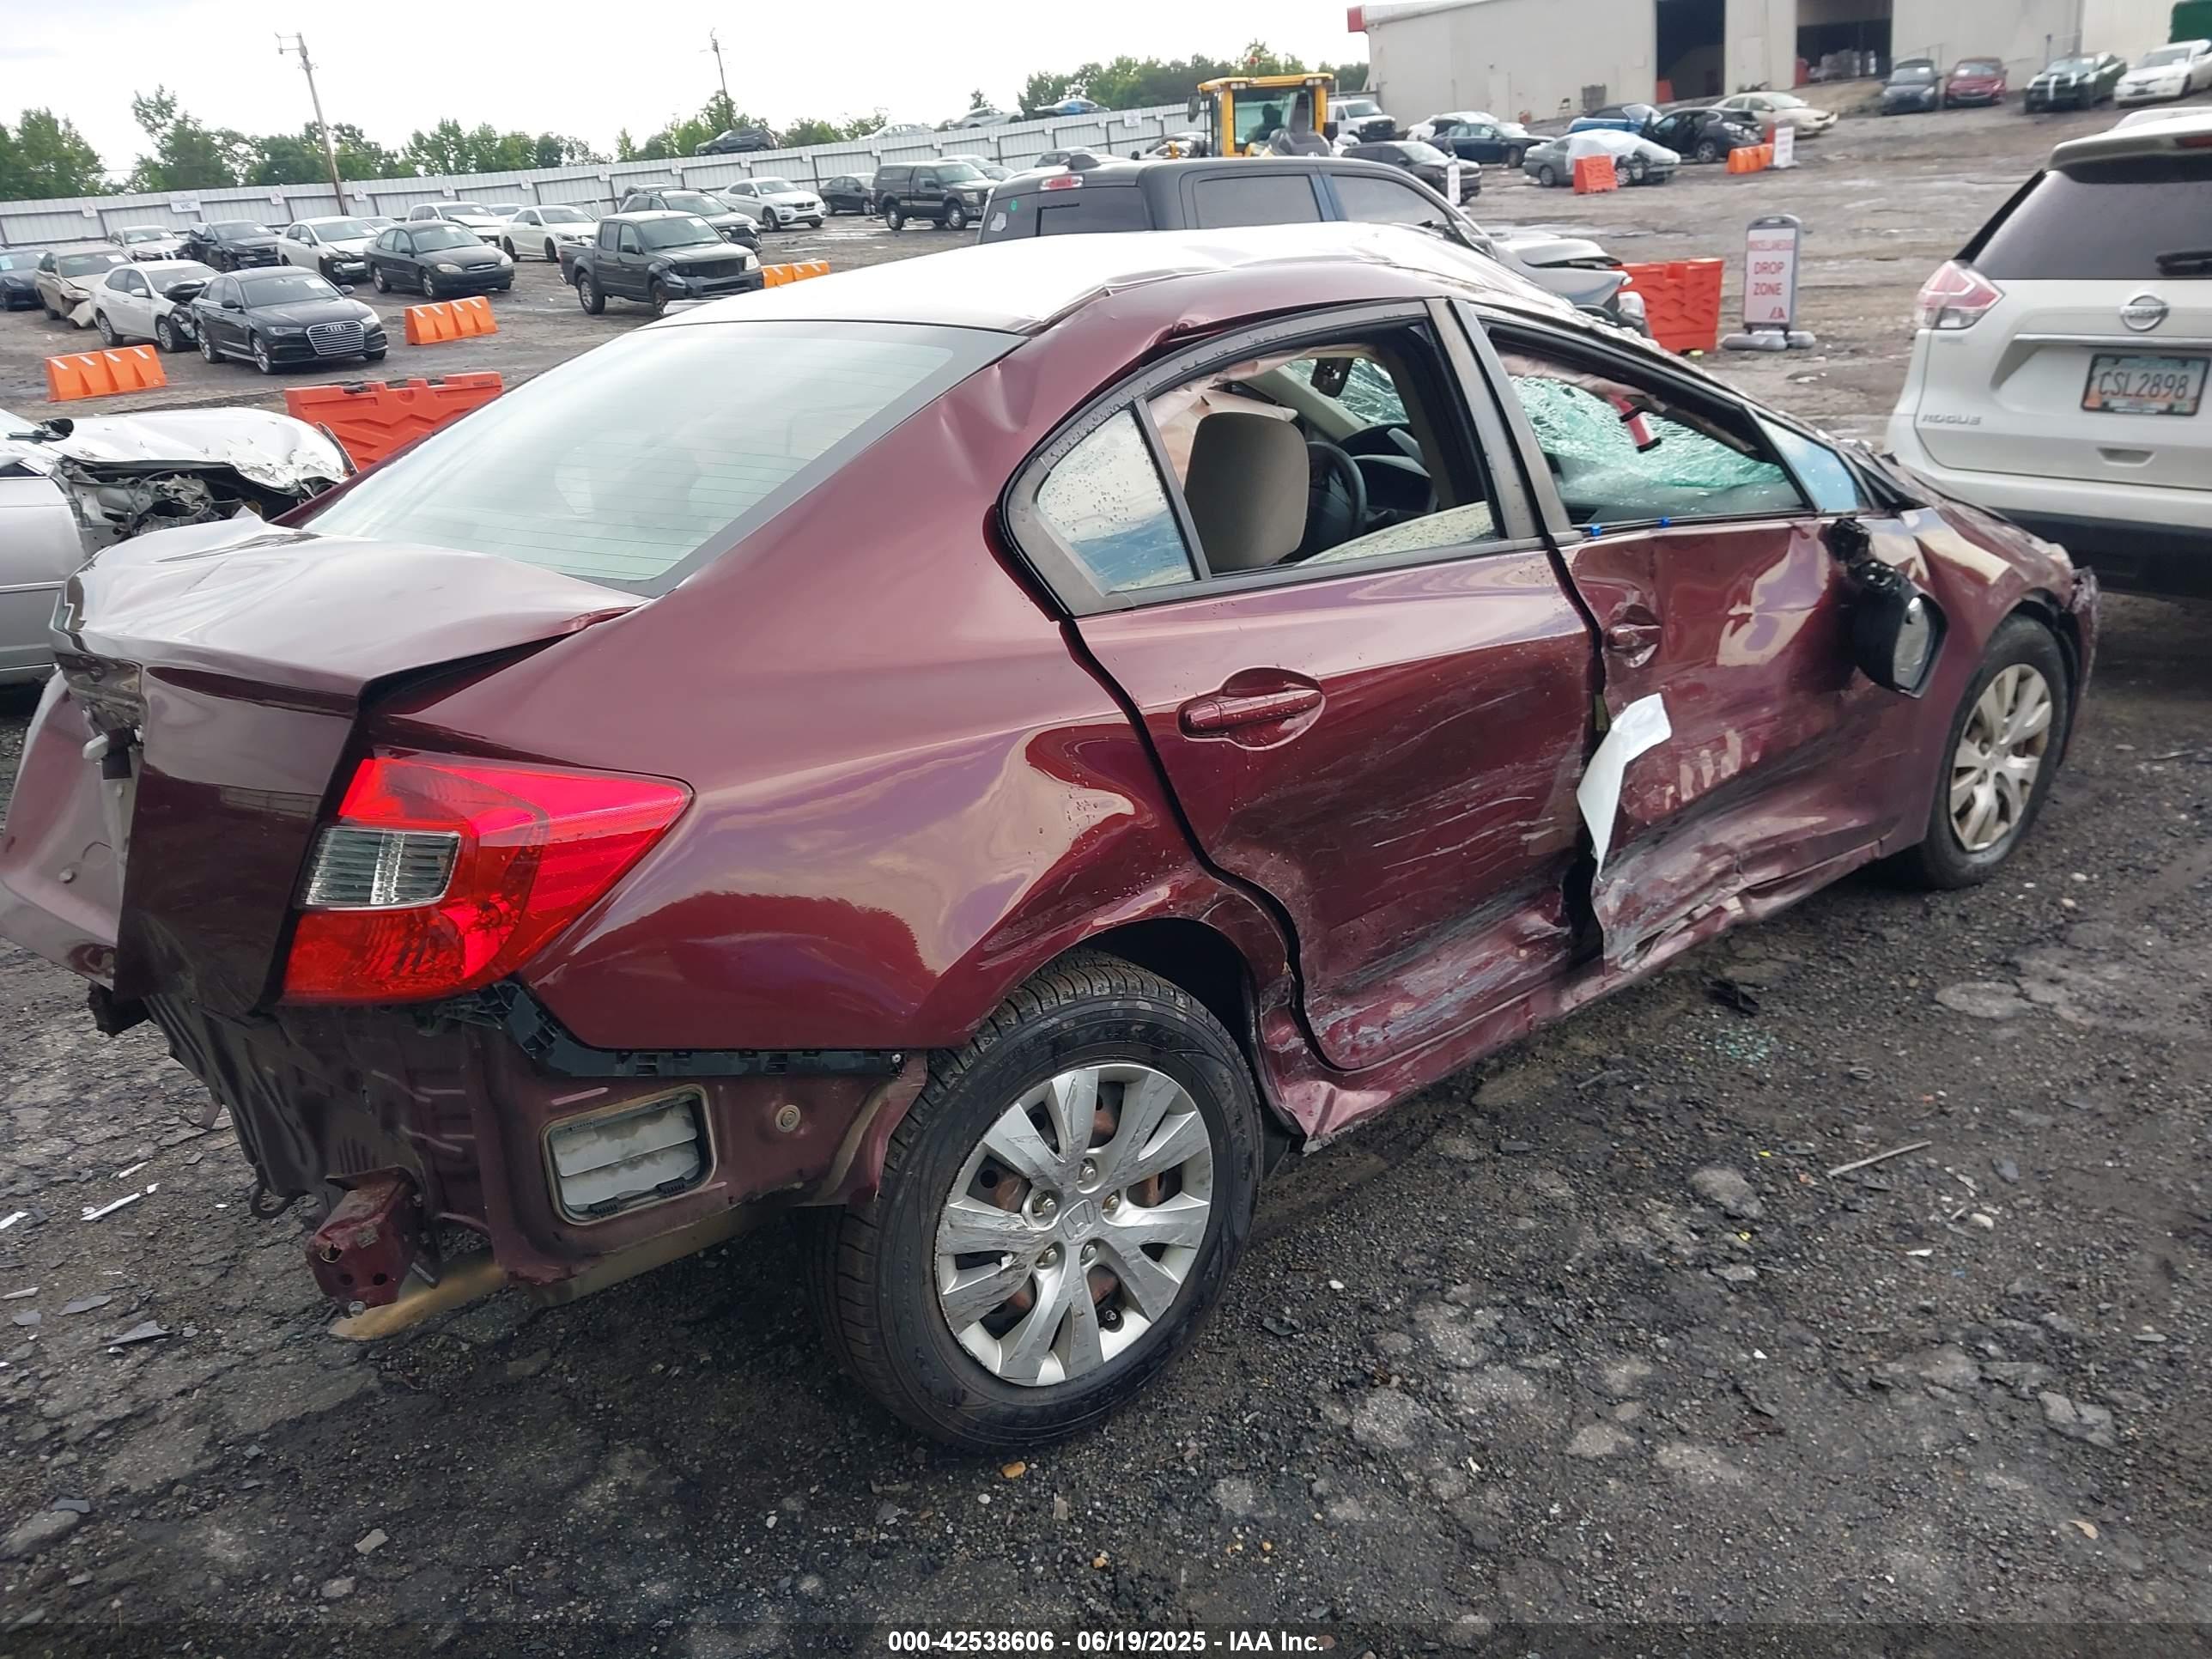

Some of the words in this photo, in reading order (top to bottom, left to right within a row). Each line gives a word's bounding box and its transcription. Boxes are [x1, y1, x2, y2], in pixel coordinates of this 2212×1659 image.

[1754, 261, 1784, 274] DROP
[1753, 283, 1782, 295] ZONE
[2098, 370, 2190, 399] CSL2898
[1922, 414, 1982, 426] ROGUE
